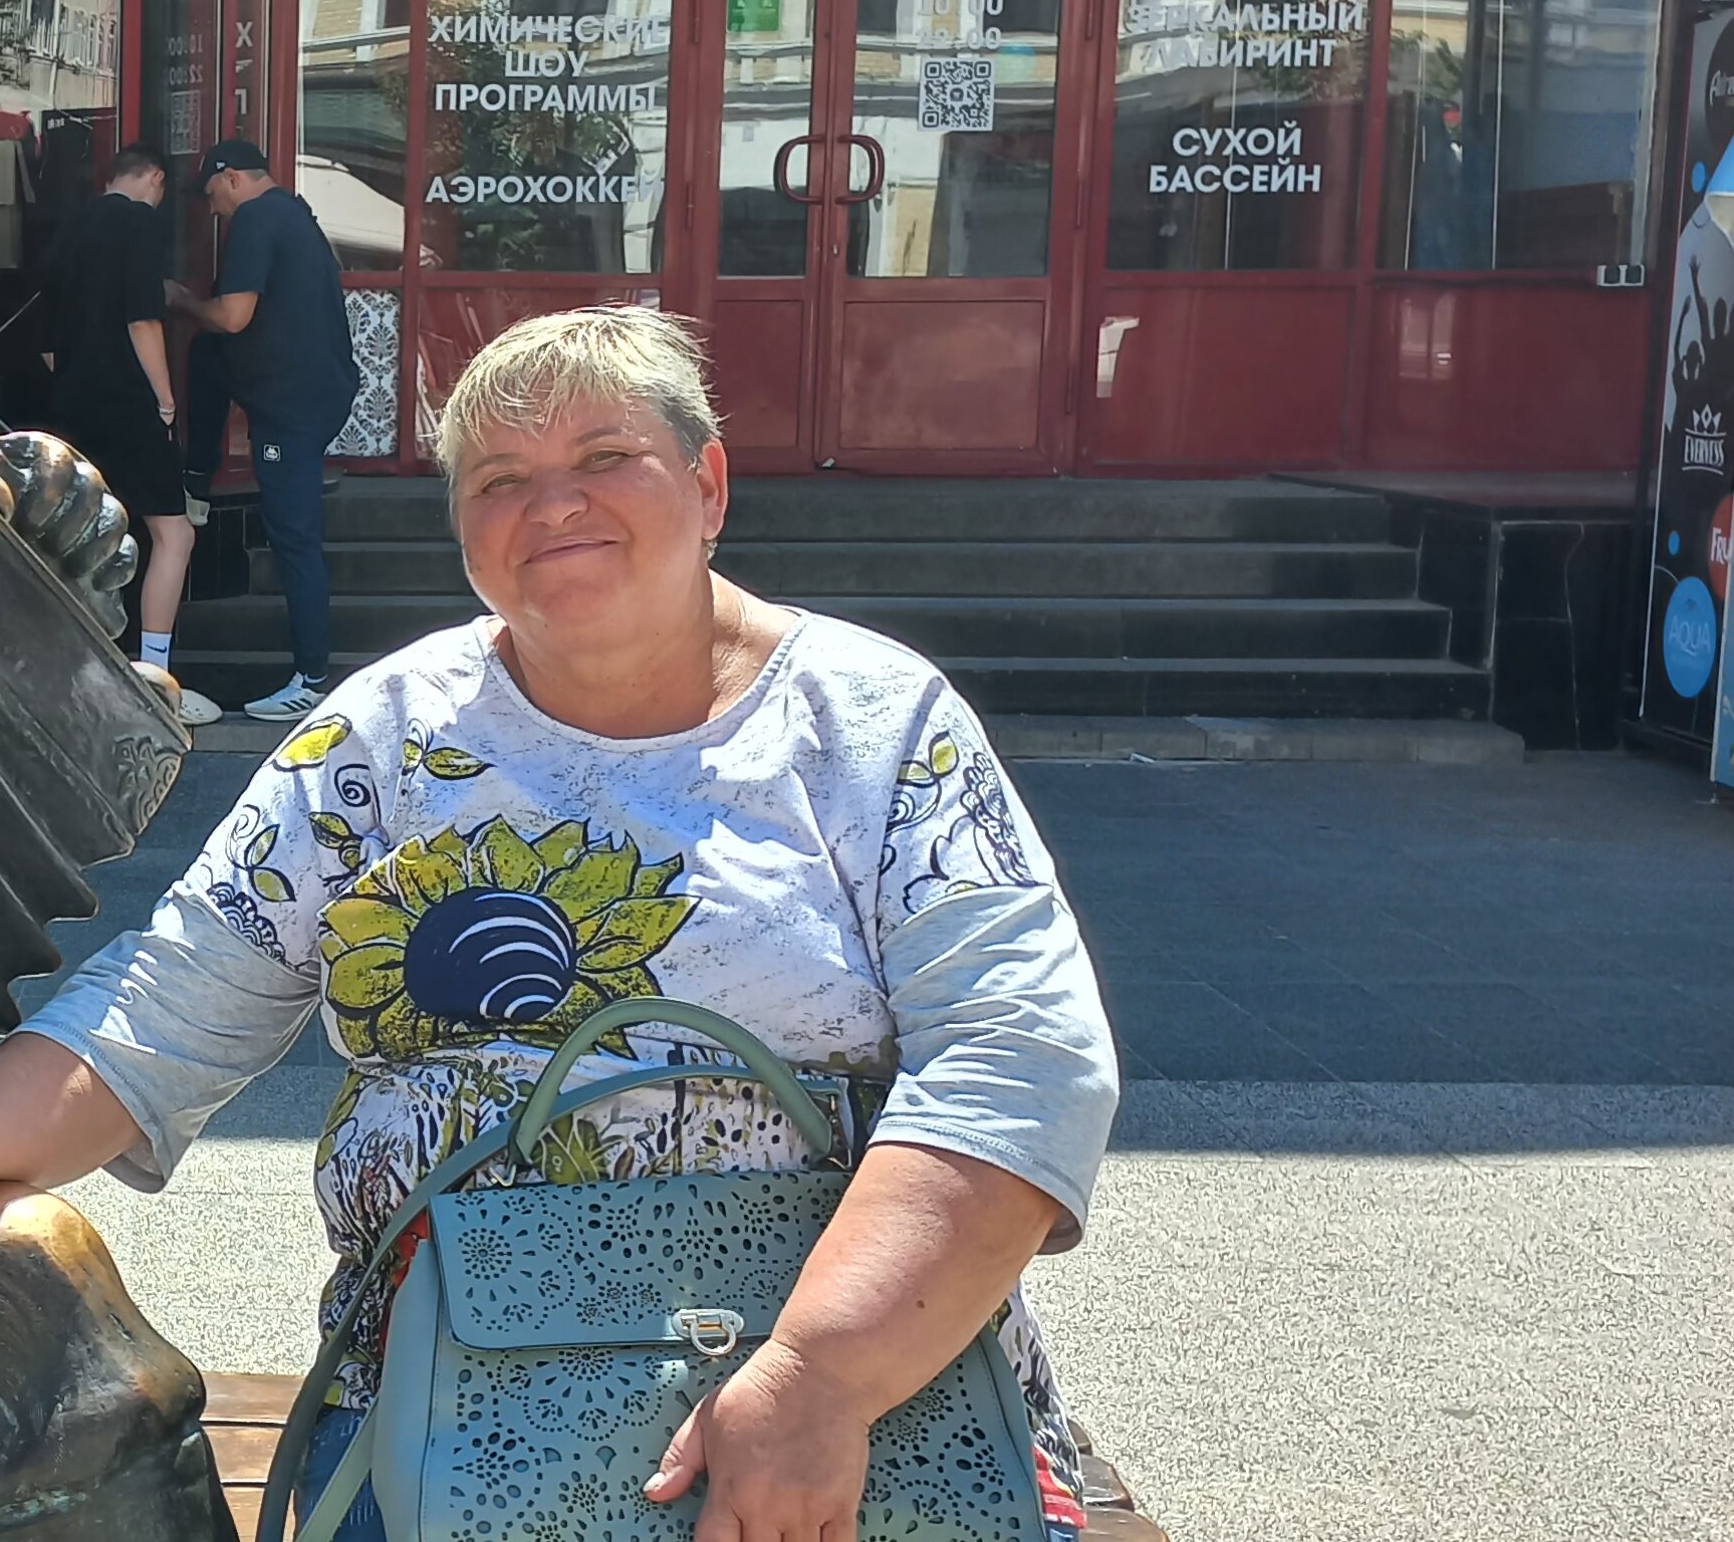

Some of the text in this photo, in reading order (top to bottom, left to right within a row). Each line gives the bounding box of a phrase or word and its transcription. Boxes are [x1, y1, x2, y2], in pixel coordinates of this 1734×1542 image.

[427, 15, 671, 45] ХИМИЧЕСКИЕ
[504, 50, 589, 77] ШОУ
[1144, 38, 1337, 68] ЛАБИРИНТ
[434, 83, 657, 111] ПРОГРАММЫ
[1172, 120, 1302, 156] СУХОЙ
[424, 174, 665, 204] АЭРОХОККЕЙ
[1148, 157, 1322, 193] БАССЕЙН
[1683, 434, 1725, 467] EVERVESS
[1668, 614, 1710, 657] AQUA
